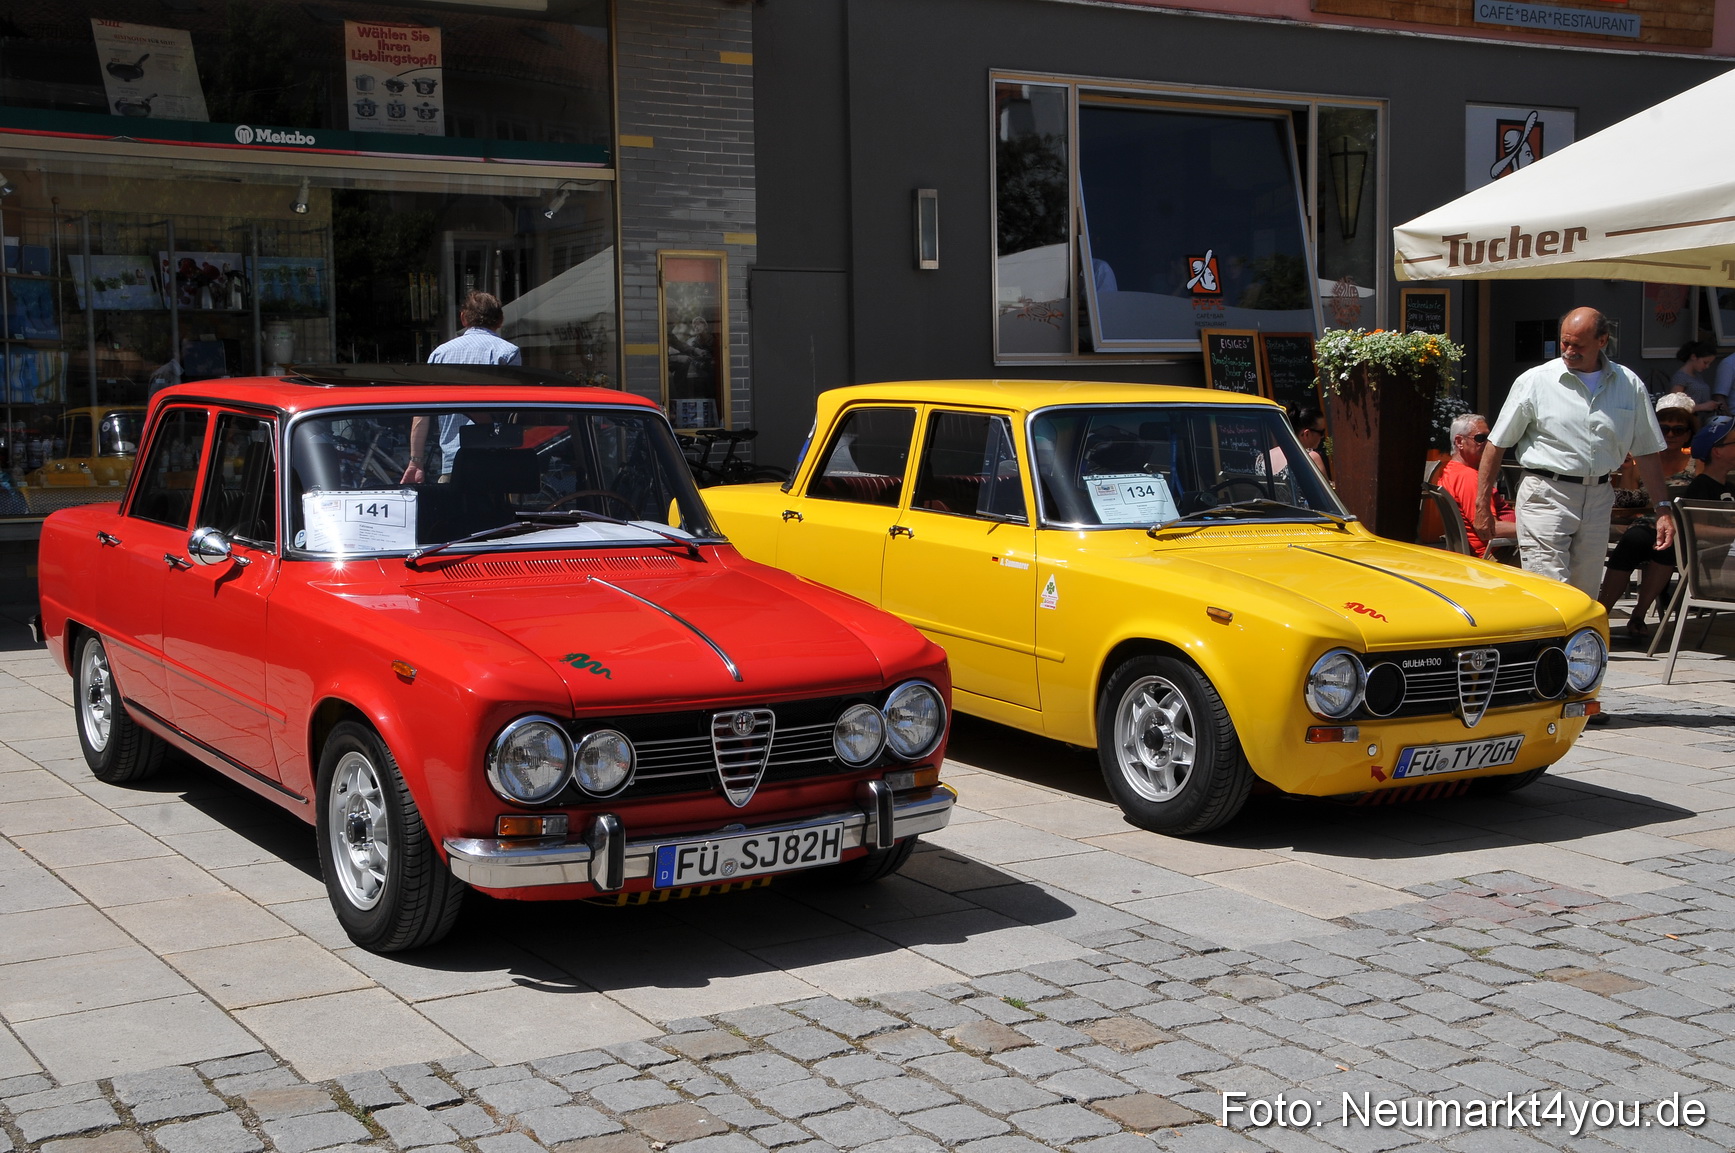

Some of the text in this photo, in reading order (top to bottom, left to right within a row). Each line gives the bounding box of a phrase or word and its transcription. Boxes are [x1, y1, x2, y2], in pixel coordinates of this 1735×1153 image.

[357, 26, 430, 42] Wählen Sie
[378, 40, 411, 52] Ihren
[351, 49, 437, 67] Lieblingstopf!
[255, 128, 316, 145] Metabo
[1441, 225, 1588, 268] Tucher
[1192, 298, 1225, 310] PEPE
[1127, 485, 1155, 498] 134
[355, 503, 389, 518] 141
[1407, 749, 1440, 774] FÜ
[661, 870, 669, 880] D
[676, 845, 719, 880] FÜ
